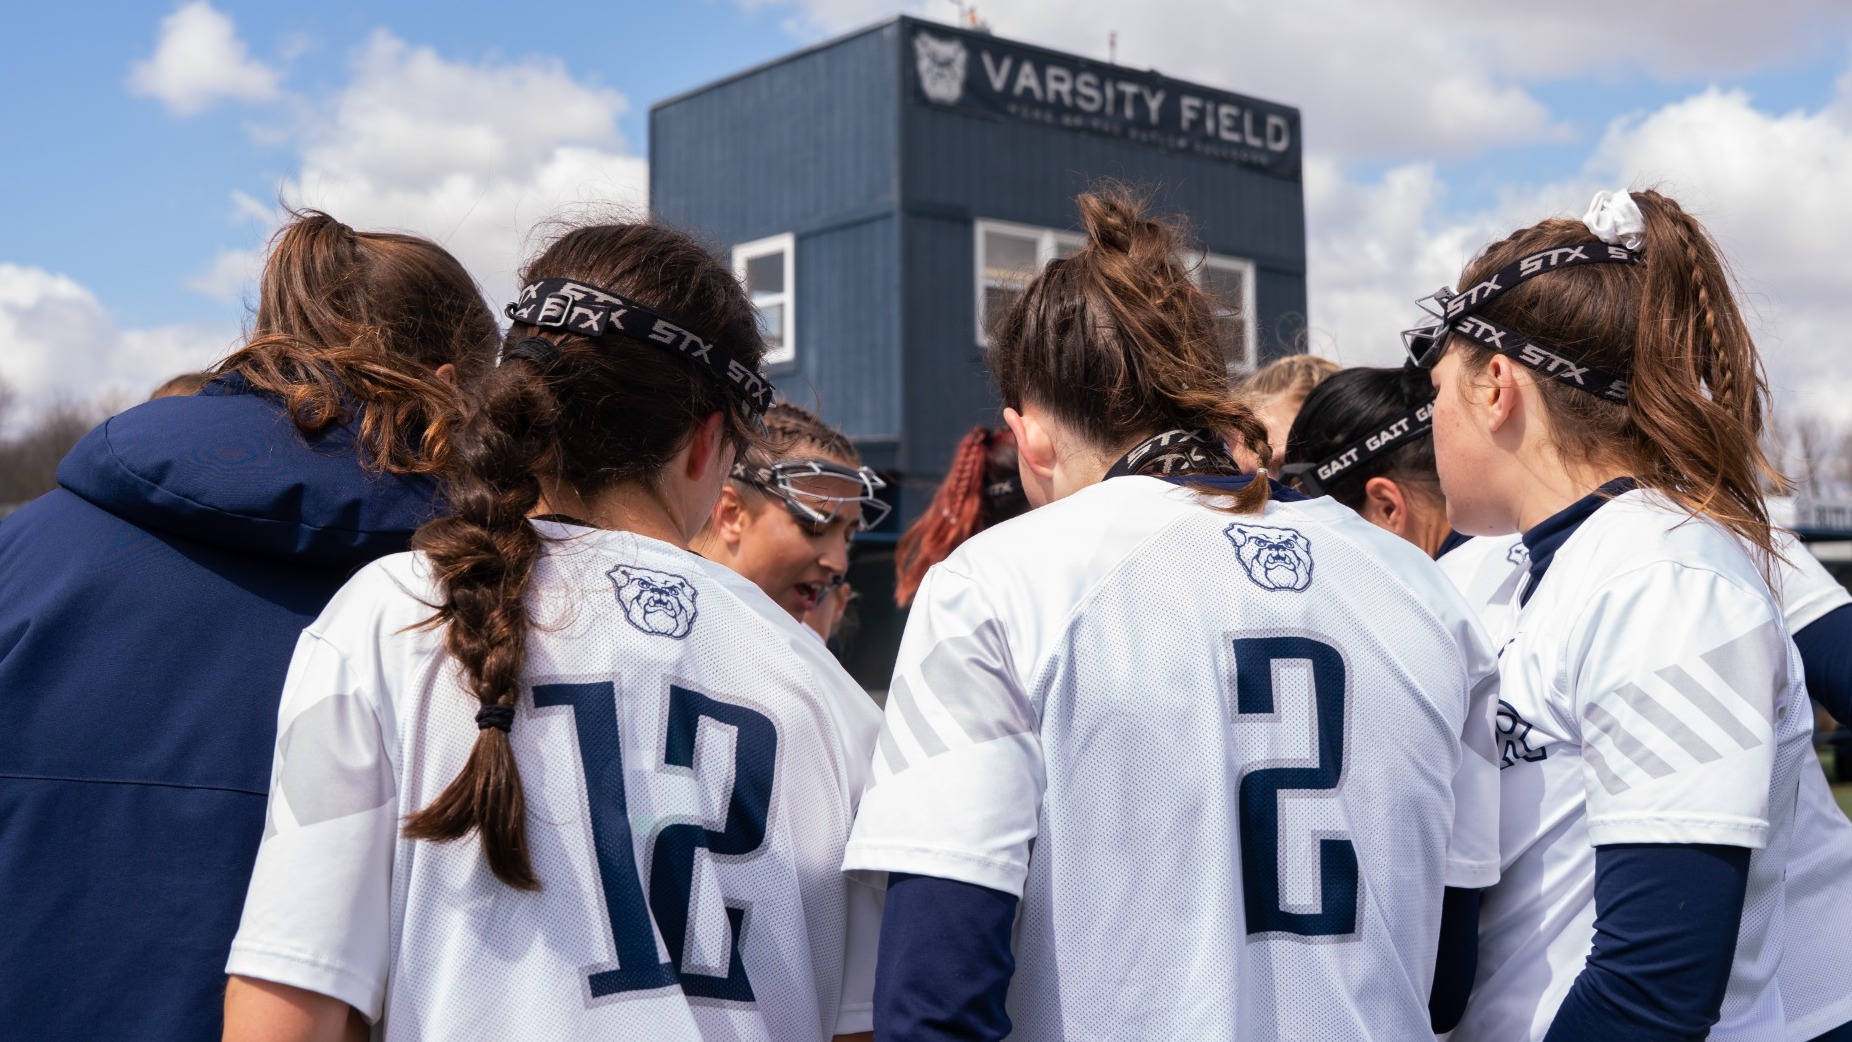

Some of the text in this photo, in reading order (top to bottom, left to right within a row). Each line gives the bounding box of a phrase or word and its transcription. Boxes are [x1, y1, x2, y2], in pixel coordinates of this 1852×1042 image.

[981, 49, 1166, 125] VARSITY
[1179, 94, 1291, 153] FIELD
[1447, 245, 1590, 320] STX STX
[649, 318, 713, 365] STX
[726, 358, 768, 406] STX
[1455, 315, 1591, 386] STX STX
[1127, 428, 1206, 470] STX
[1317, 399, 1437, 480] GAIT GAIT GA
[1223, 629, 1366, 944] 2
[524, 673, 784, 1010] 12
